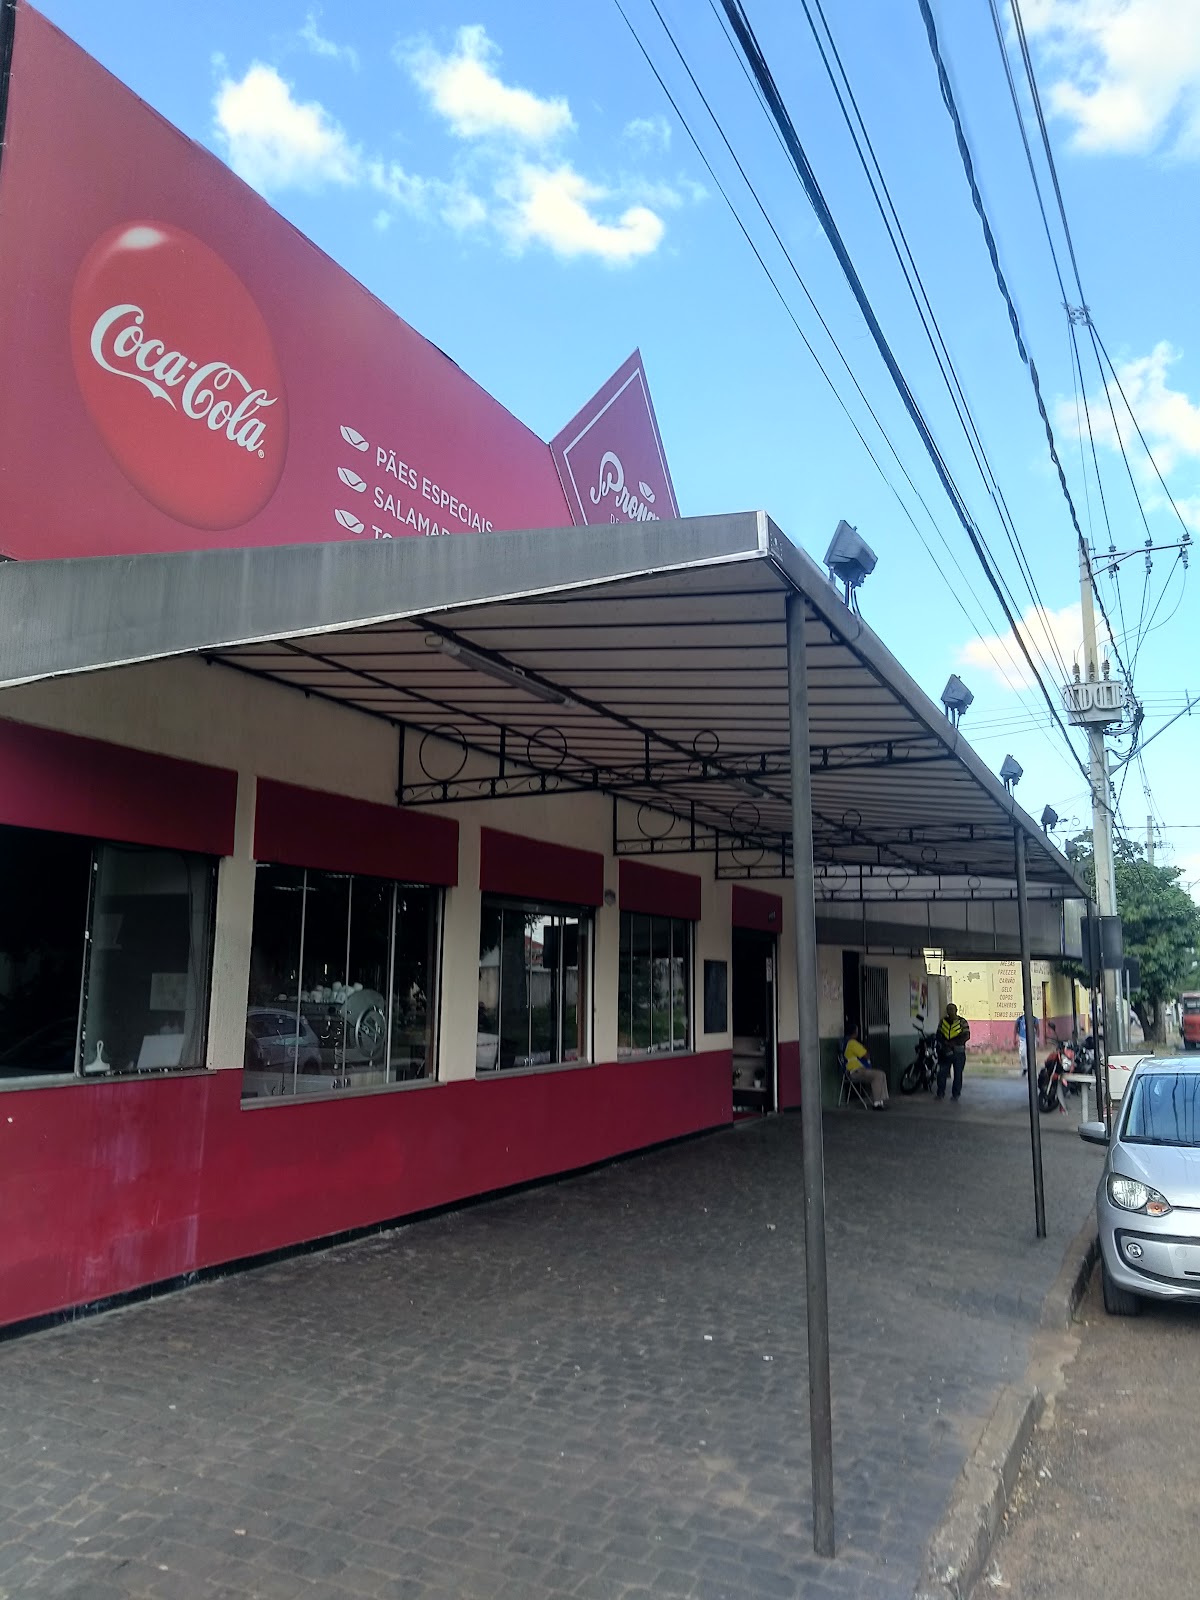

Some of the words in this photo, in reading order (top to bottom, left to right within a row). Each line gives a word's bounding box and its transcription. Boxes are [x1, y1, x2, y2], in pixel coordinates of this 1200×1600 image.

[90, 304, 278, 452] Coca-Cola
[376, 446, 418, 490] PÃES
[422, 477, 493, 533] ESPECIAIS
